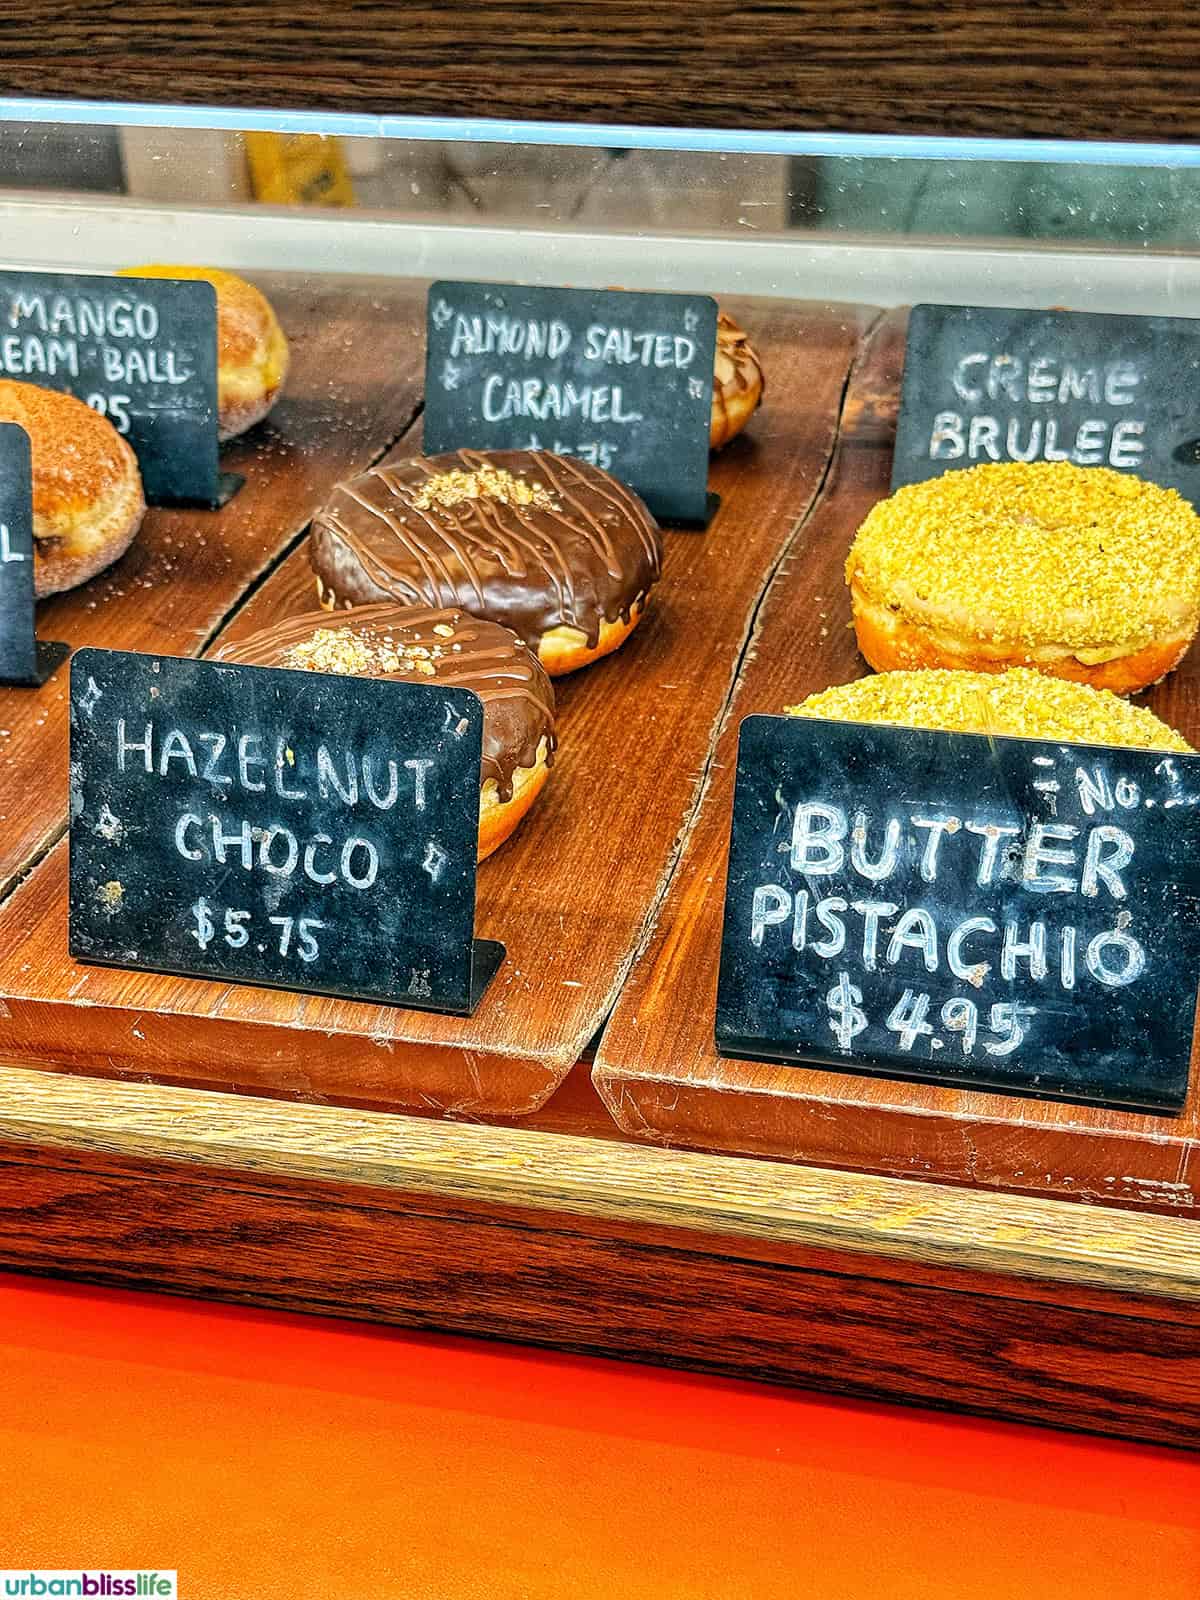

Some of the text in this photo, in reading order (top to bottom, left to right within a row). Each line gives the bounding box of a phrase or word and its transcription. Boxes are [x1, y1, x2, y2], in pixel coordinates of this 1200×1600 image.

[11, 294, 160, 340] MANGO
[451, 313, 696, 369] ALMOND SALTED
[0, 334, 191, 385] EAM BALL
[953, 352, 1140, 405] CREME
[482, 373, 643, 424] CARAMEL
[929, 410, 1146, 468] BRULEE
[116, 718, 435, 811] HAZELNUT
[174, 813, 380, 889] CHOCO
[789, 801, 1135, 900] BUTTER
[190, 896, 325, 962] $5.75
[751, 884, 1146, 990] PISTACHIO
